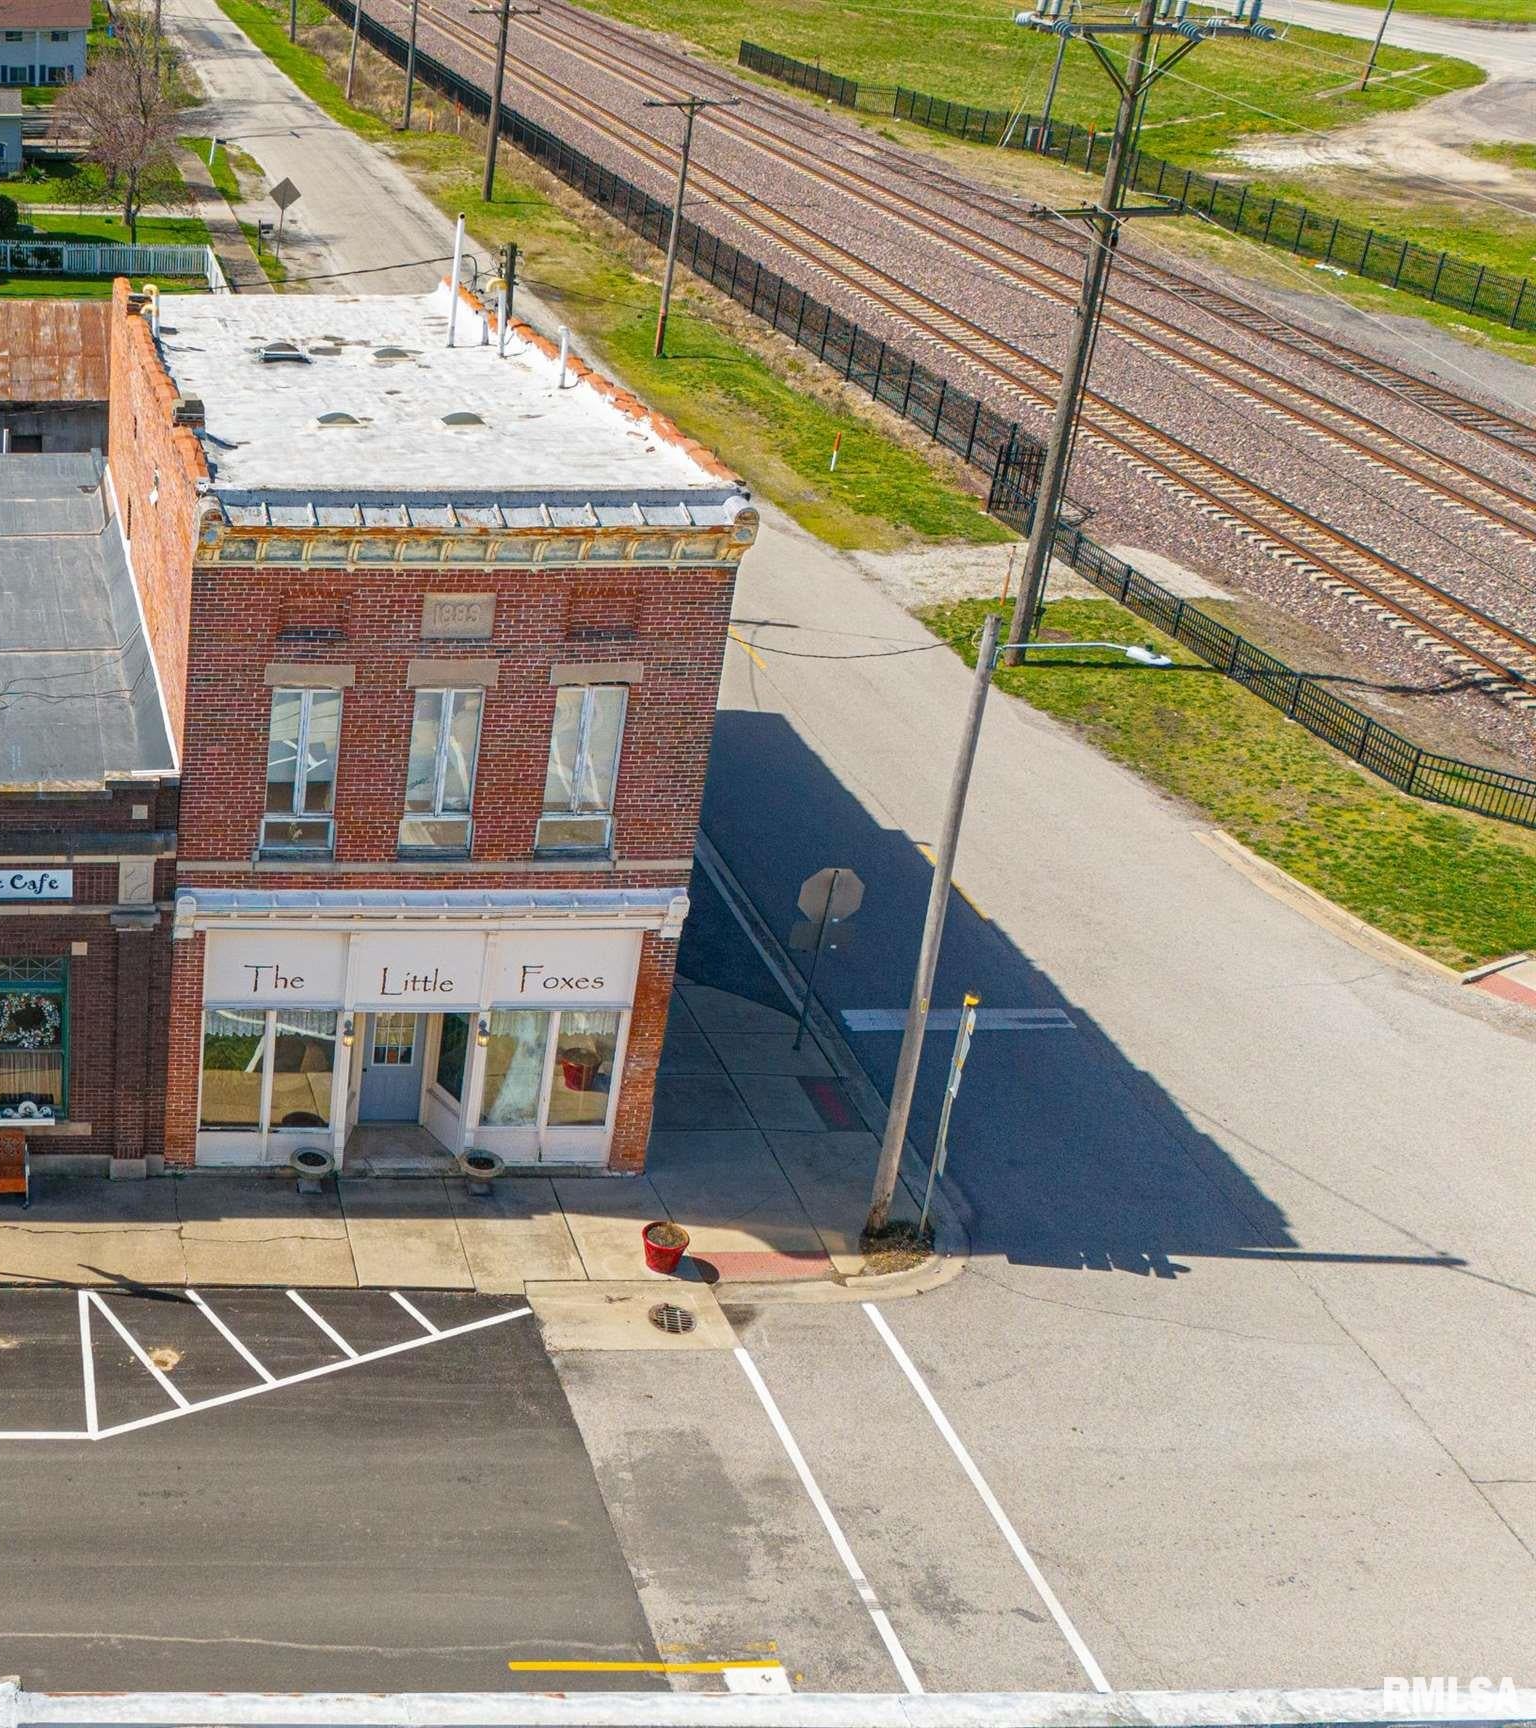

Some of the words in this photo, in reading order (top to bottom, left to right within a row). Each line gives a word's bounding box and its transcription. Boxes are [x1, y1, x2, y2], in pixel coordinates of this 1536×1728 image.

[10, 873, 59, 895] Cafe
[244, 964, 305, 993] The
[380, 967, 455, 996] Little
[519, 964, 605, 993] Foxes
